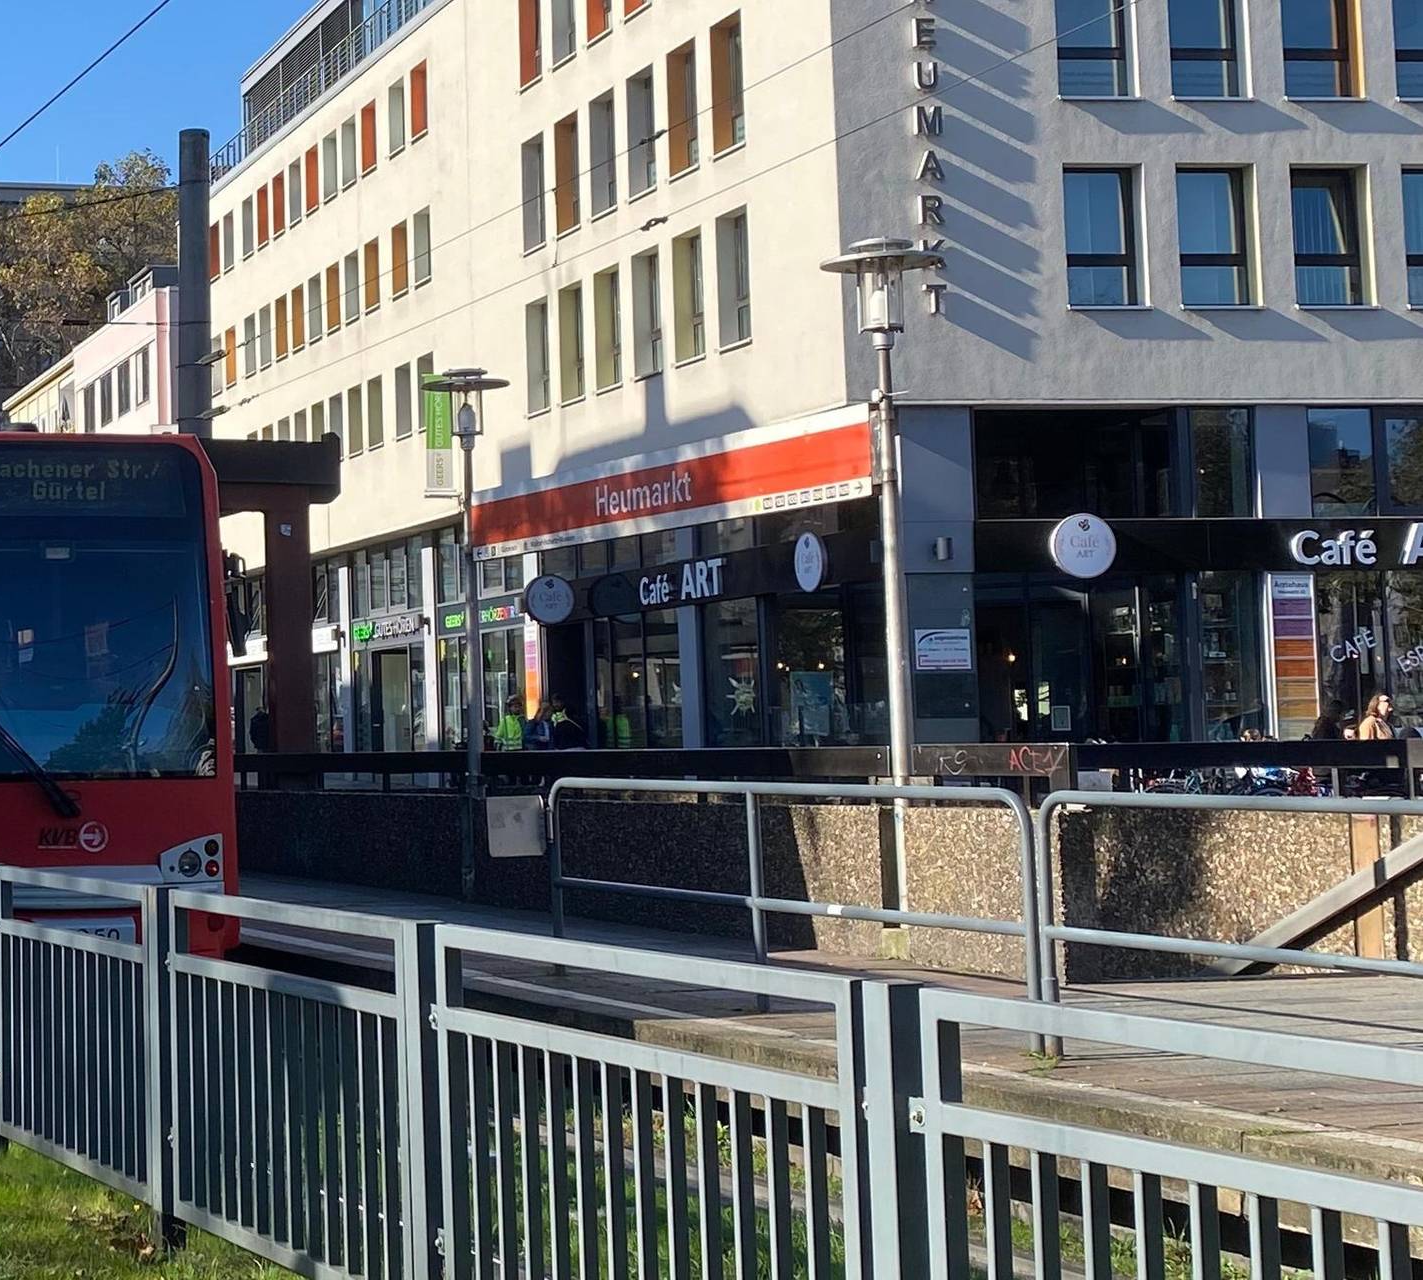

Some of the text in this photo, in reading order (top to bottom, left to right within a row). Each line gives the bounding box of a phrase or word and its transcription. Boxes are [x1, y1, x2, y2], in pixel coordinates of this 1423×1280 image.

[911, 0, 948, 315] EUMARKT
[106, 459, 161, 479] Str./
[33, 480, 106, 501] Gürtel
[595, 470, 692, 517] Heumarkt
[1290, 529, 1377, 566] Café
[639, 557, 725, 606] Café ART
[39, 826, 78, 846] KVB
